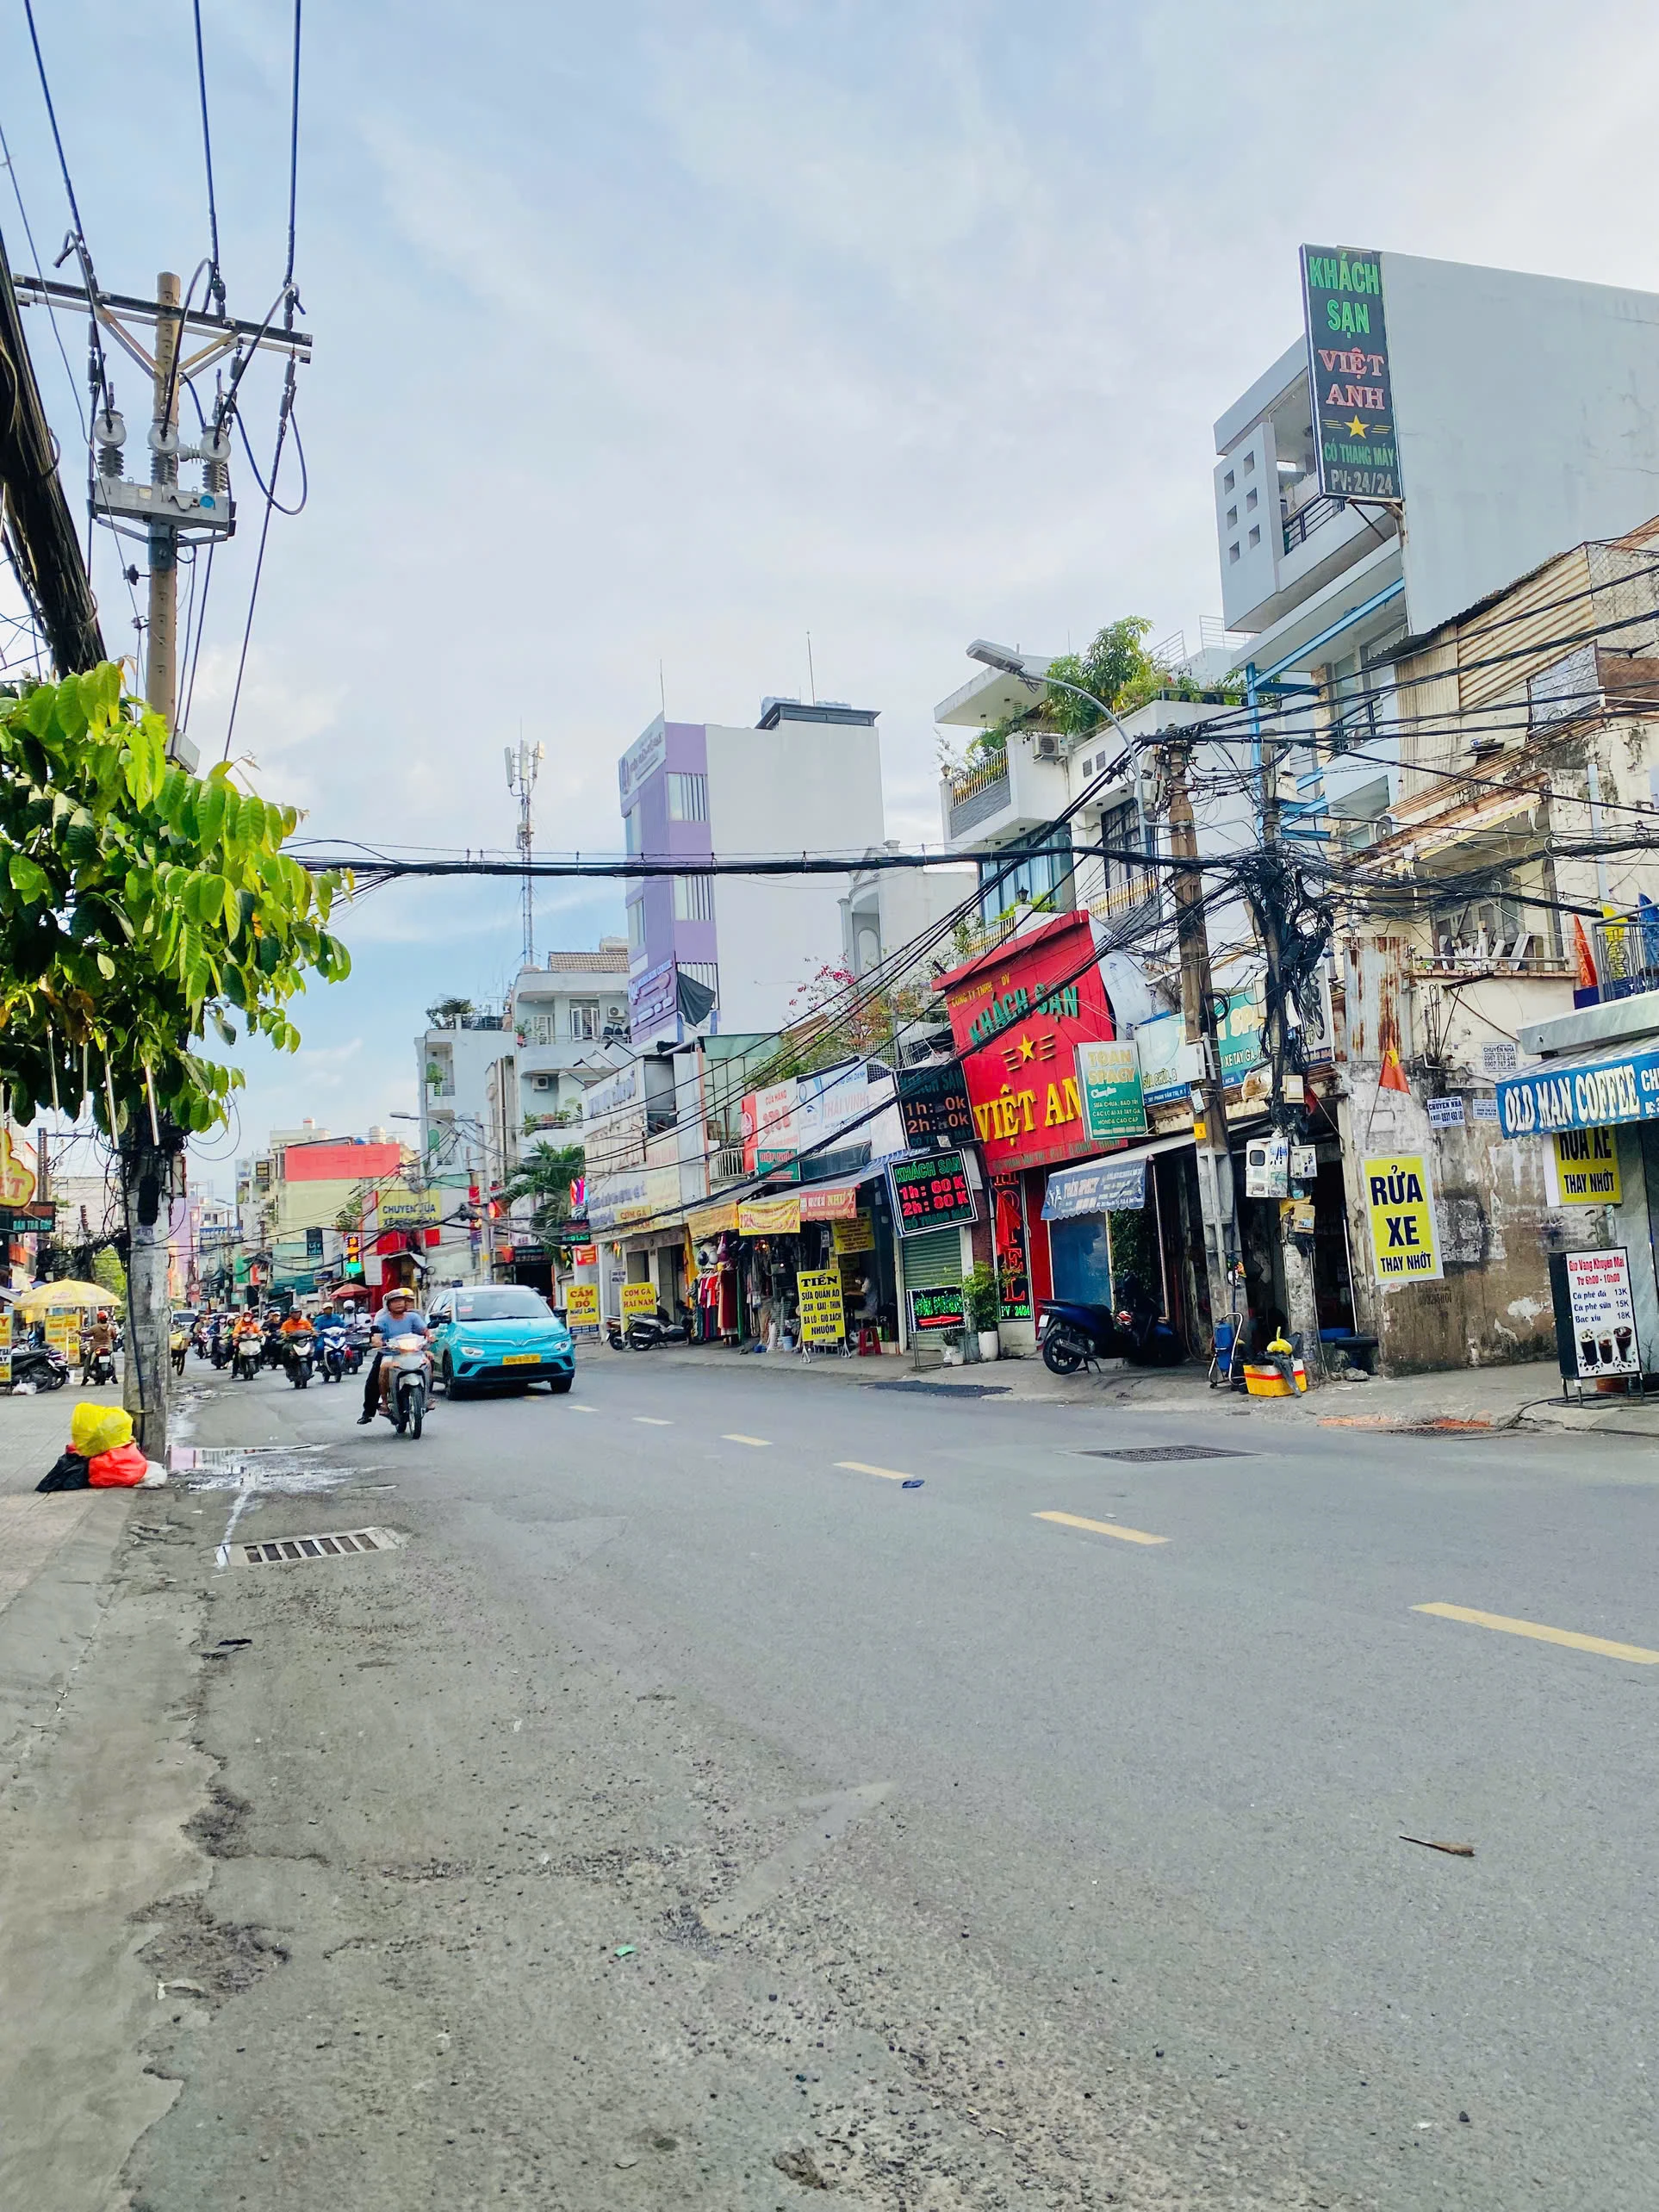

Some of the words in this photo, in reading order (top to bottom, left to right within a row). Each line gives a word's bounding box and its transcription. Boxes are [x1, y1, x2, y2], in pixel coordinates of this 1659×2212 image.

[1308, 252, 1380, 294] KHÁCH
[1327, 299, 1370, 339] SẠN
[1318, 346, 1385, 379] VIỆT
[1326, 383, 1385, 410] ANH
[1324, 438, 1337, 462] CÓ
[1339, 443, 1372, 466] THANG
[1373, 443, 1395, 467] MÁY
[1225, 1054, 1233, 1068] XE
[1233, 1051, 1244, 1066] TAY
[1088, 1068, 1135, 1085] SPACY
[973, 1084, 1036, 1146] VIỆT
[1045, 1076, 1083, 1127] AN
[1504, 1084, 1535, 1133] OLD
[1536, 1077, 1573, 1128] MAN
[1575, 1064, 1640, 1123] COFFEE
[1640, 1067, 1659, 1091] CH
[895, 1161, 936, 1183] KHÁCH
[938, 1156, 962, 1176] SẠN
[1563, 1173, 1587, 1194] THAY
[1589, 1168, 1614, 1193] NHỚT
[931, 1178, 951, 1194] 60
[953, 1175, 966, 1190] K
[1370, 1165, 1424, 1206] RỬA
[933, 1194, 954, 1209] 80
[956, 1190, 969, 1204] K
[1385, 1215, 1420, 1247] XE
[1380, 1256, 1403, 1273] THAY
[1406, 1251, 1432, 1271] NHỚT
[801, 1273, 837, 1287] TIẾN
[1617, 1311, 1631, 1320] 18K
